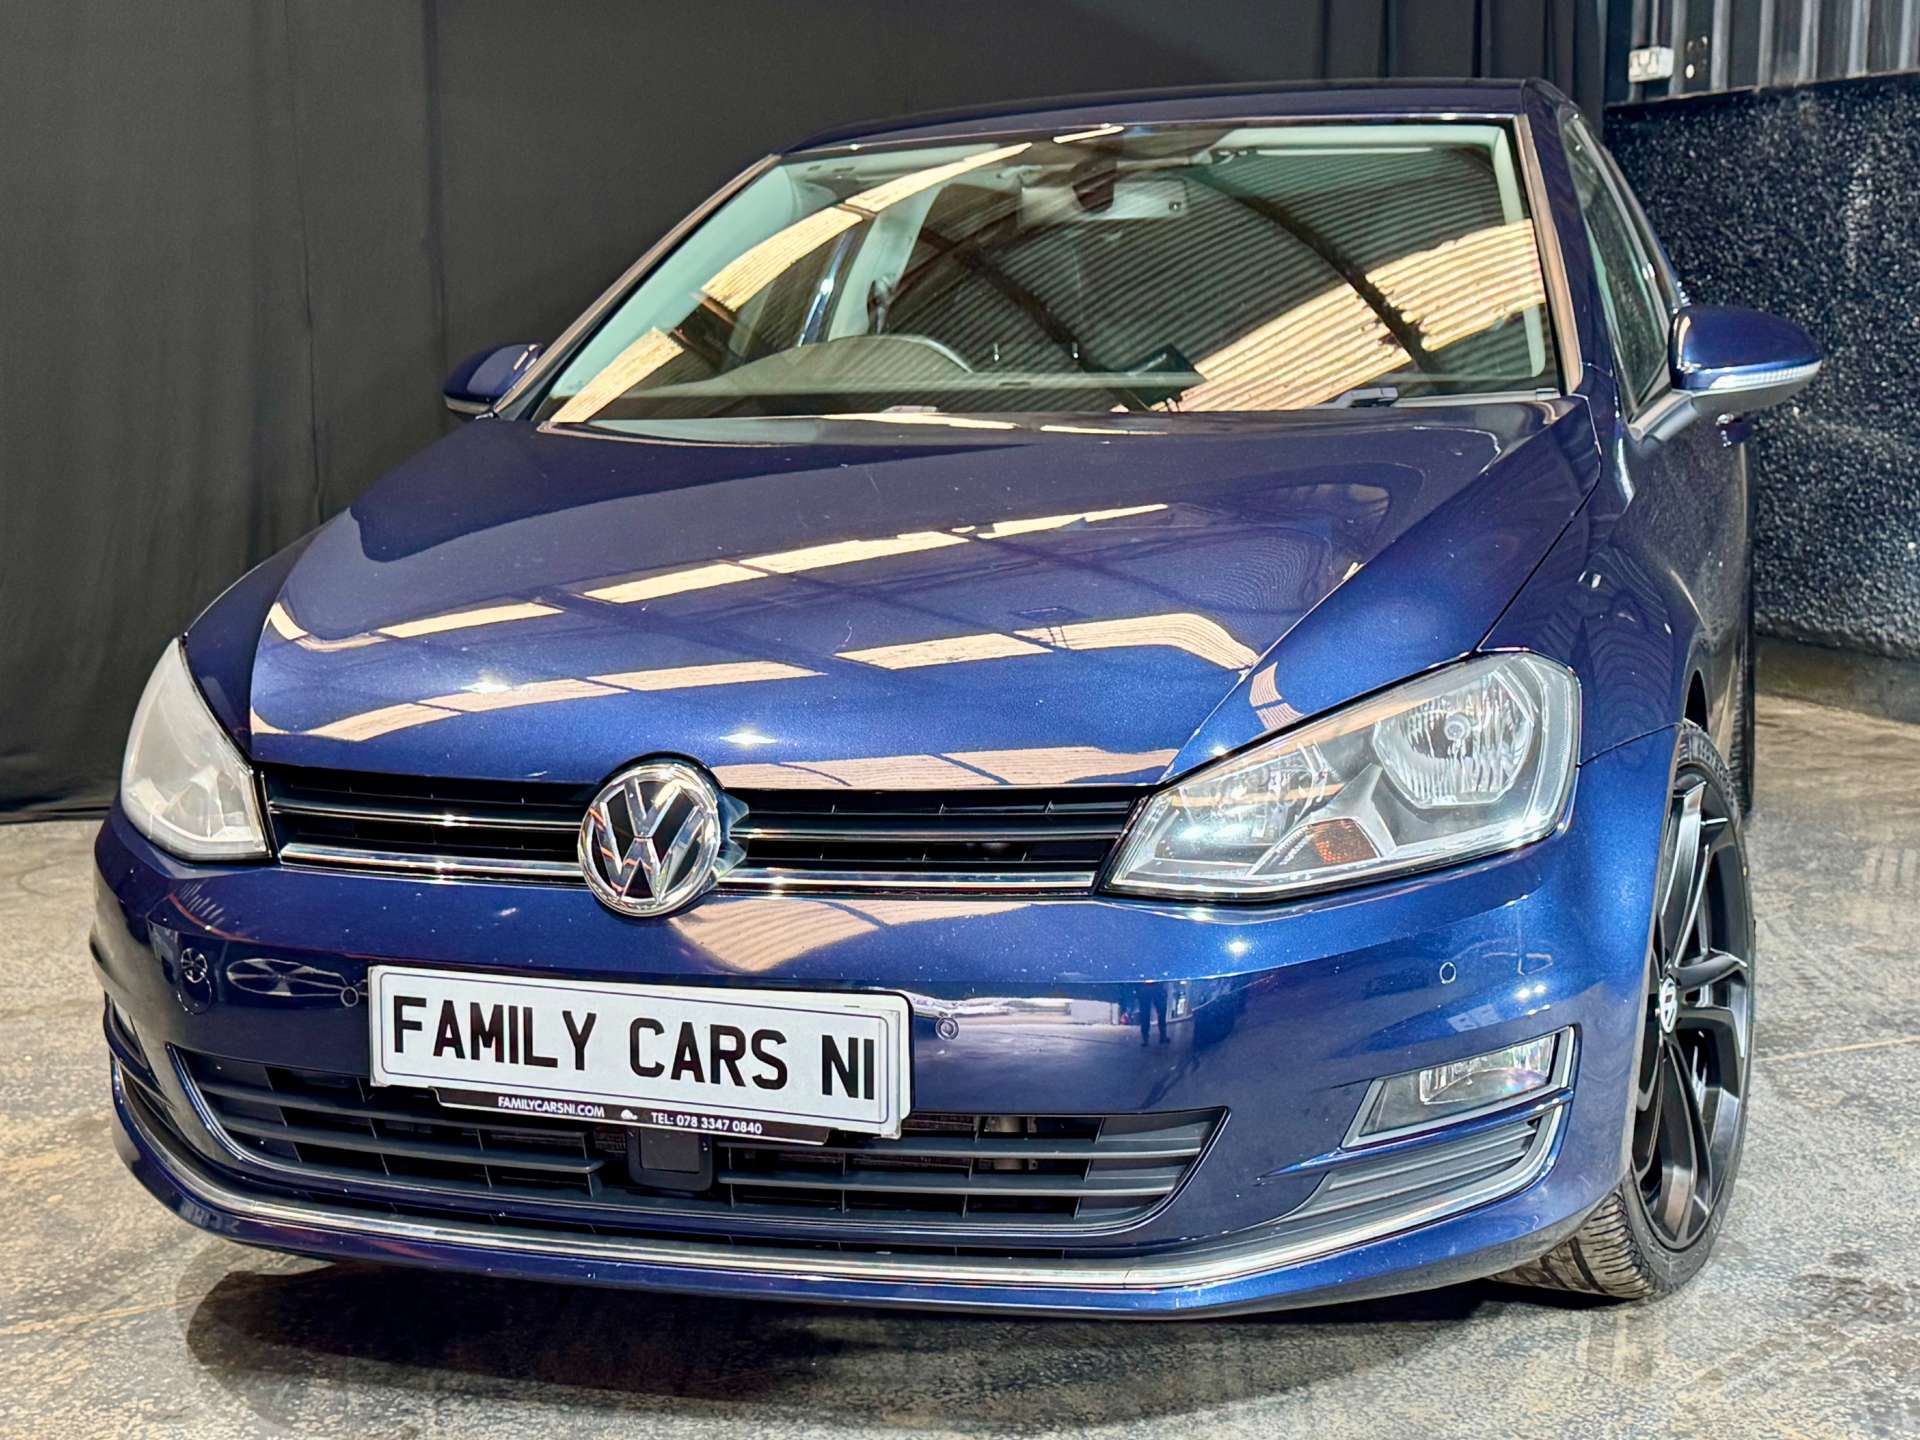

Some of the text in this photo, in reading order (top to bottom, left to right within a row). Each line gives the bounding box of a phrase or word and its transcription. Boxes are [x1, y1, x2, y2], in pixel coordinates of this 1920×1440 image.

[394, 996, 875, 1101] FAMILY CARS NI
[498, 1096, 605, 1118] FAMILYCARSNI.COM
[650, 1112, 674, 1125] TEL:
[676, 1114, 698, 1128] 078
[701, 1117, 730, 1131] 3347
